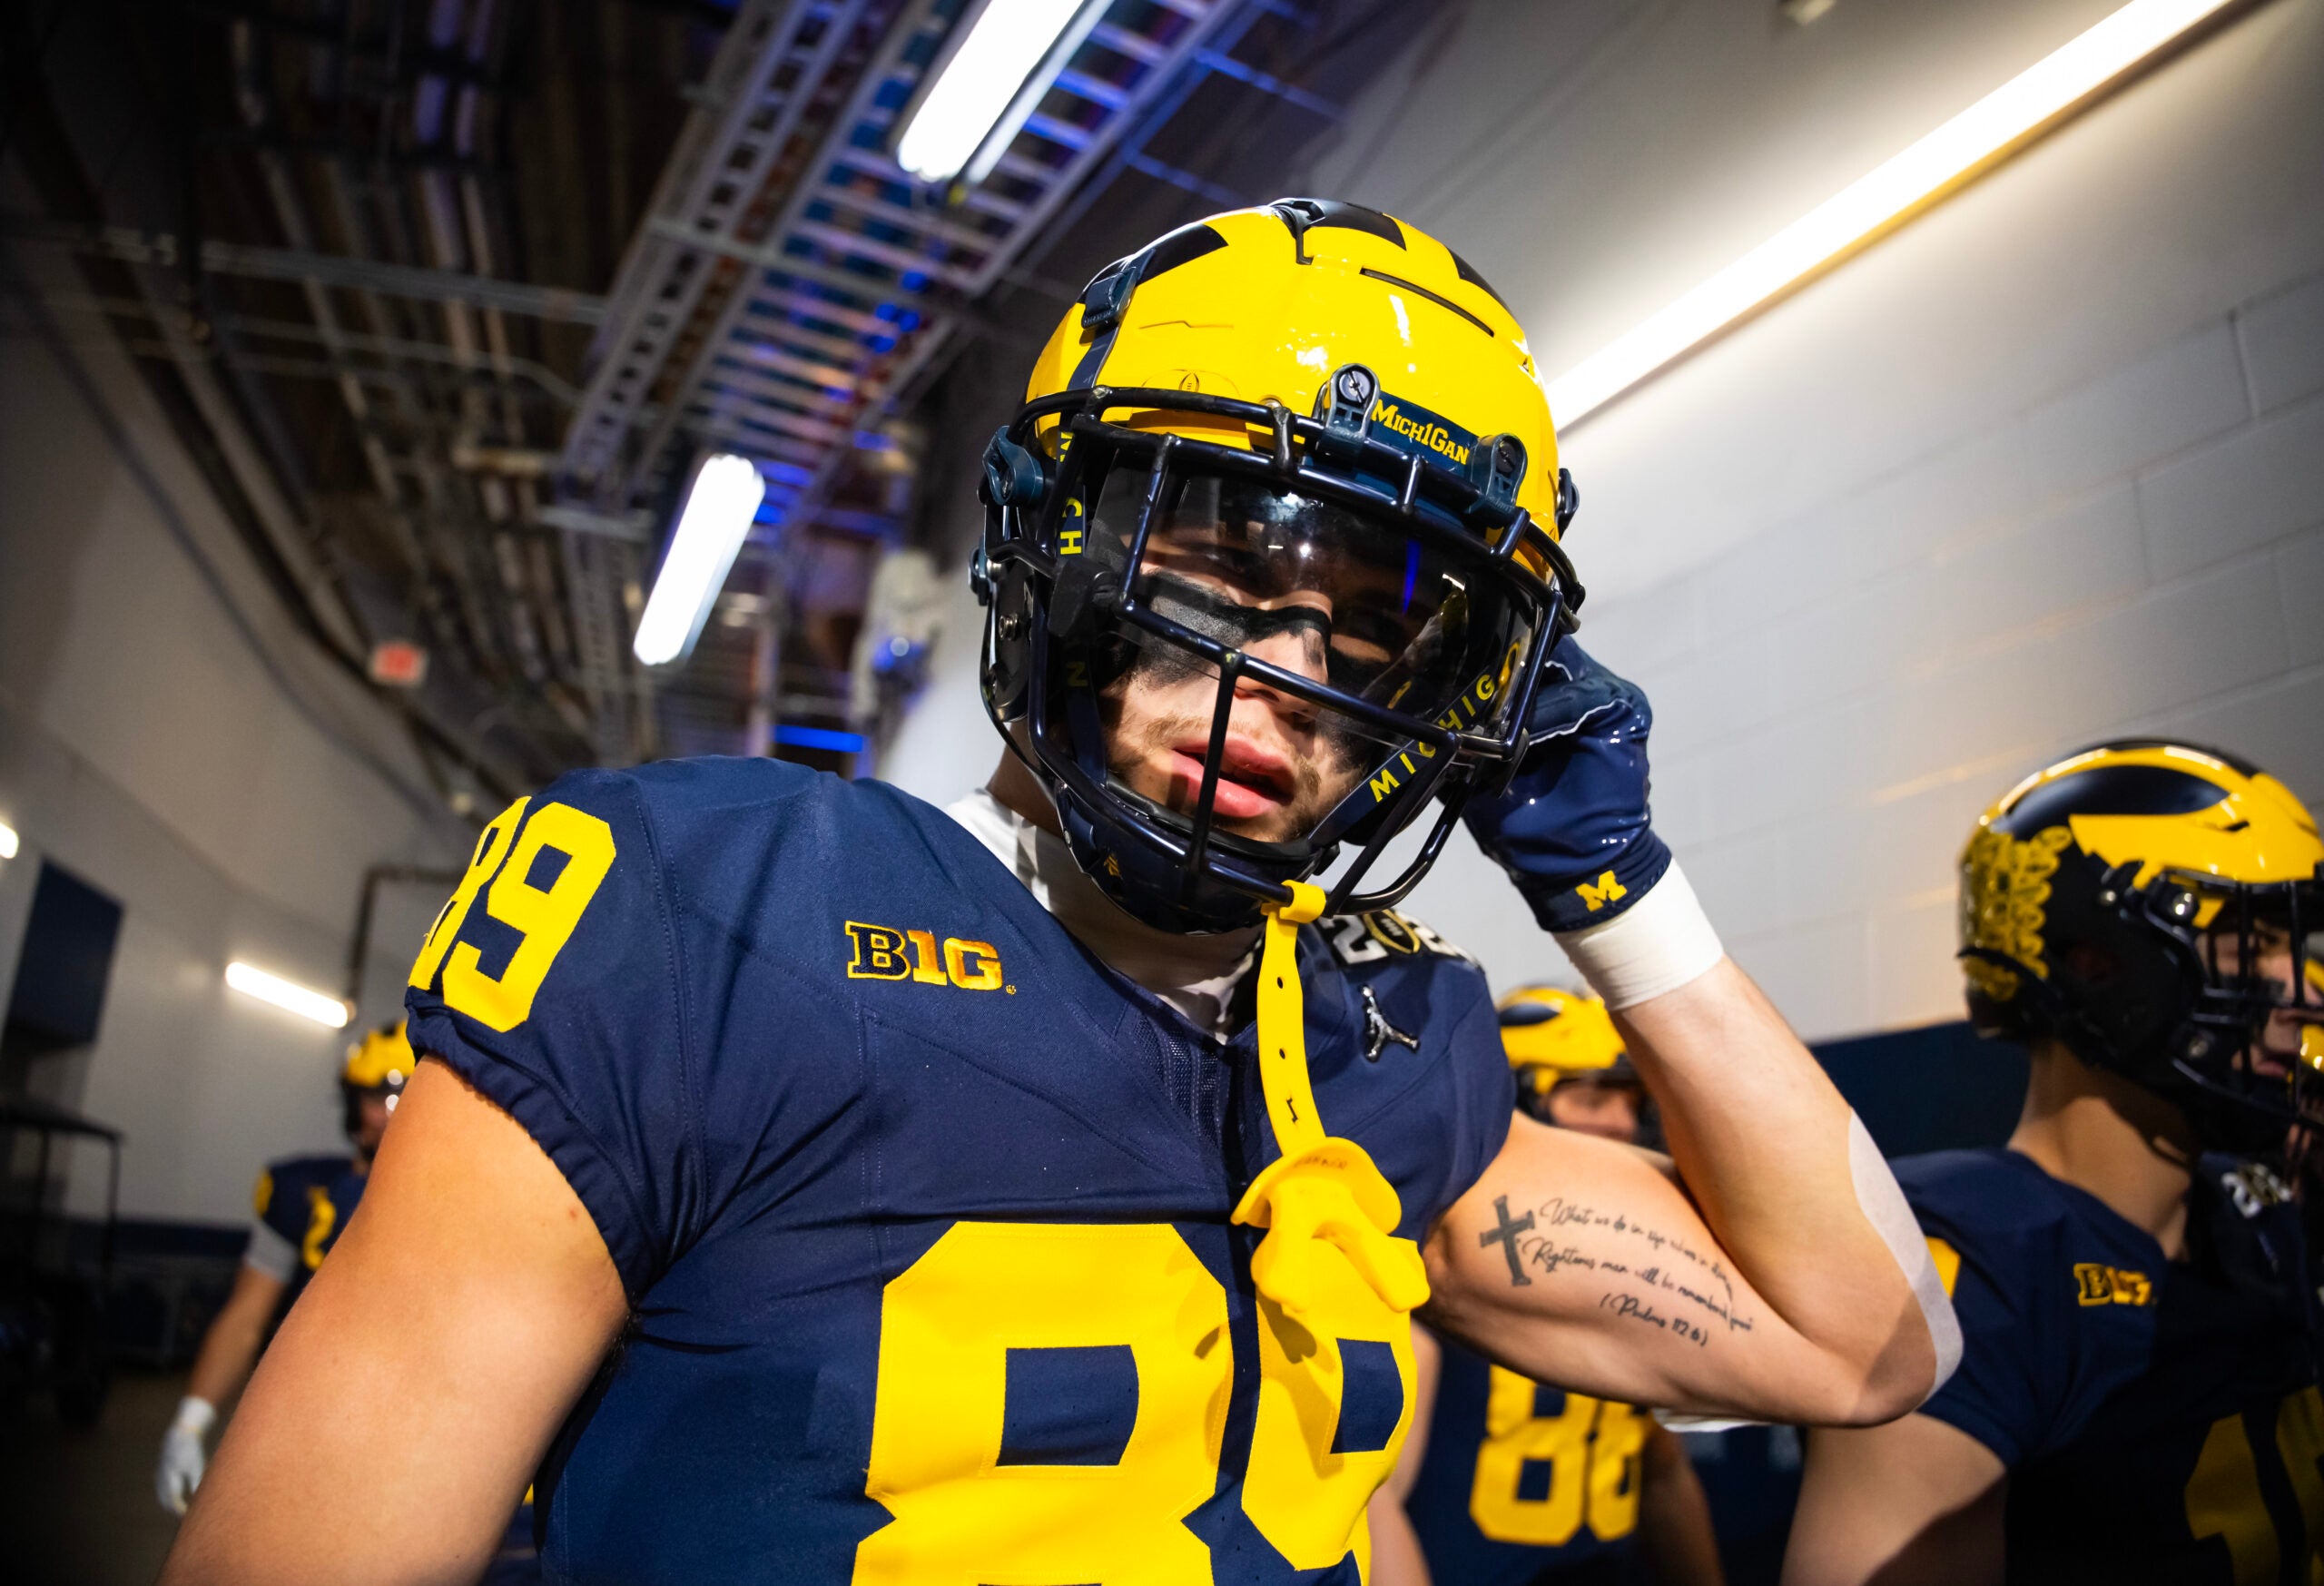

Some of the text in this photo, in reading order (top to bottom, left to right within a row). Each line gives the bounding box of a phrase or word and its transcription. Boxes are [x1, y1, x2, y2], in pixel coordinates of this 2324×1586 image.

[408, 796, 617, 1032] 89
[1575, 870, 1627, 911] M
[1540, 1197, 1594, 1225] What
[851, 1221, 1418, 1586] 89
